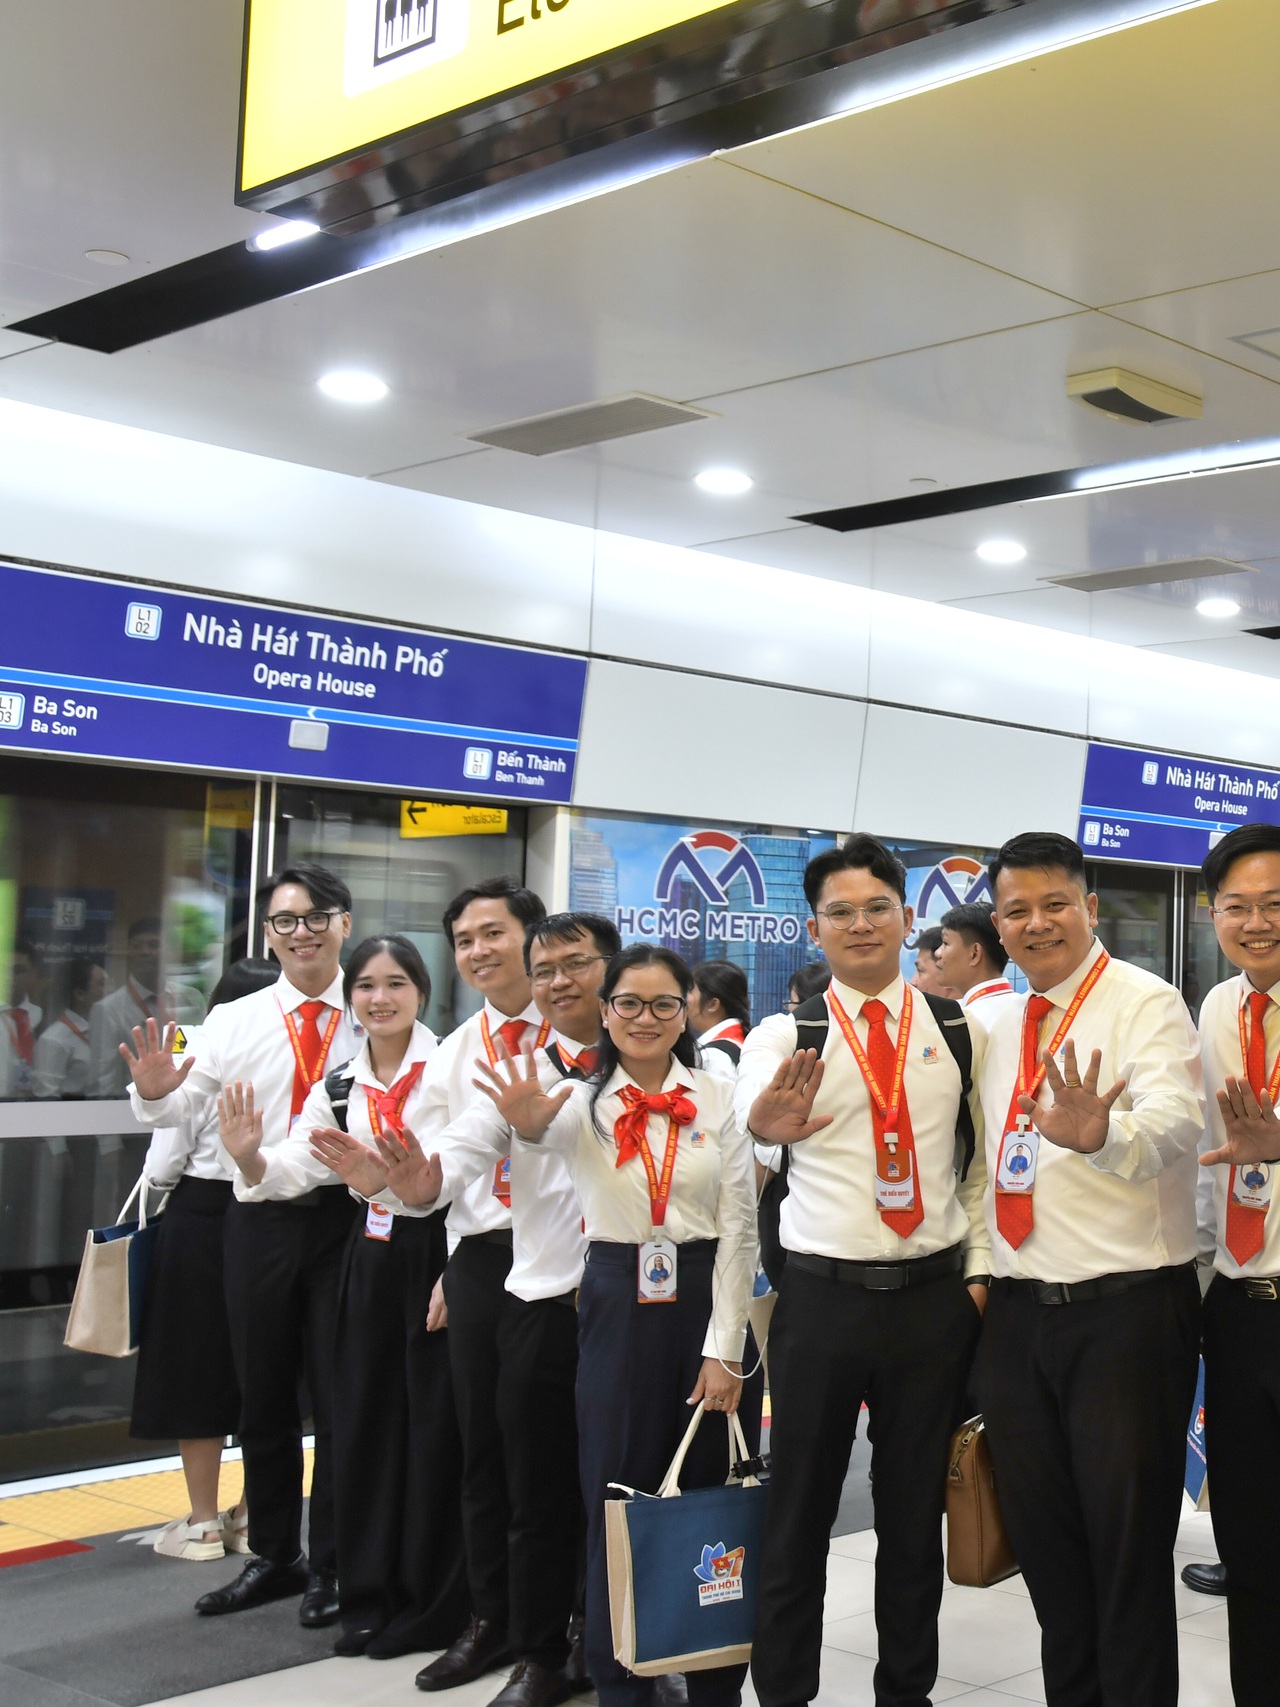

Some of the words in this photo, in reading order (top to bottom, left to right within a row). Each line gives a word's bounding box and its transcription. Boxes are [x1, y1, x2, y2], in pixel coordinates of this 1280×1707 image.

[138, 608, 151, 621] L1
[135, 622, 150, 634] 02
[183, 612, 243, 649] Nhà
[251, 623, 300, 657] Hát
[306, 631, 387, 670] Thành
[394, 645, 449, 678] Phố
[253, 663, 312, 690] Opera
[316, 671, 376, 698] House
[33, 695, 58, 715] Ba
[62, 699, 98, 720] Son
[31, 719, 49, 733] Ba
[51, 721, 77, 736] Son
[497, 750, 524, 769] Bến
[527, 754, 566, 773] Thành
[495, 771, 514, 783] Ben
[516, 772, 545, 787] Thanh
[1166, 766, 1192, 787] Nhà
[1194, 770, 1216, 791] Hát
[1219, 774, 1253, 796] Thành
[1256, 780, 1280, 800] Phố
[1194, 796, 1220, 812] Opera
[1221, 799, 1248, 815] House
[1103, 823, 1113, 835] Ba
[1114, 825, 1130, 837] Son
[1101, 838, 1109, 847] Ba
[1110, 839, 1121, 848] Son
[616, 907, 699, 938] HCMC
[707, 912, 799, 942] METRO
[1077, 967, 1099, 999] COMMUNIST
[1067, 998, 1081, 1016] YOUTH
[842, 1022, 854, 1039] YOUTH
[1058, 1016, 1071, 1035] UNION
[1050, 1042, 1058, 1050] HO
[1054, 1034, 1062, 1042] OF
[850, 1038, 862, 1055] UNION
[858, 1054, 865, 1063] OF
[861, 1062, 870, 1071] HO
[865, 1070, 874, 1081] CHI
[893, 1073, 901, 1091] THANH
[1029, 1077, 1039, 1090] CITY
[1271, 1067, 1280, 1086] THANH
[870, 1080, 881, 1096] MINH
[877, 1095, 886, 1108] CITY
[659, 1183, 667, 1196] CITY
[700, 1584, 716, 1594] ĐẠI
[718, 1579, 734, 1590] HỘI
